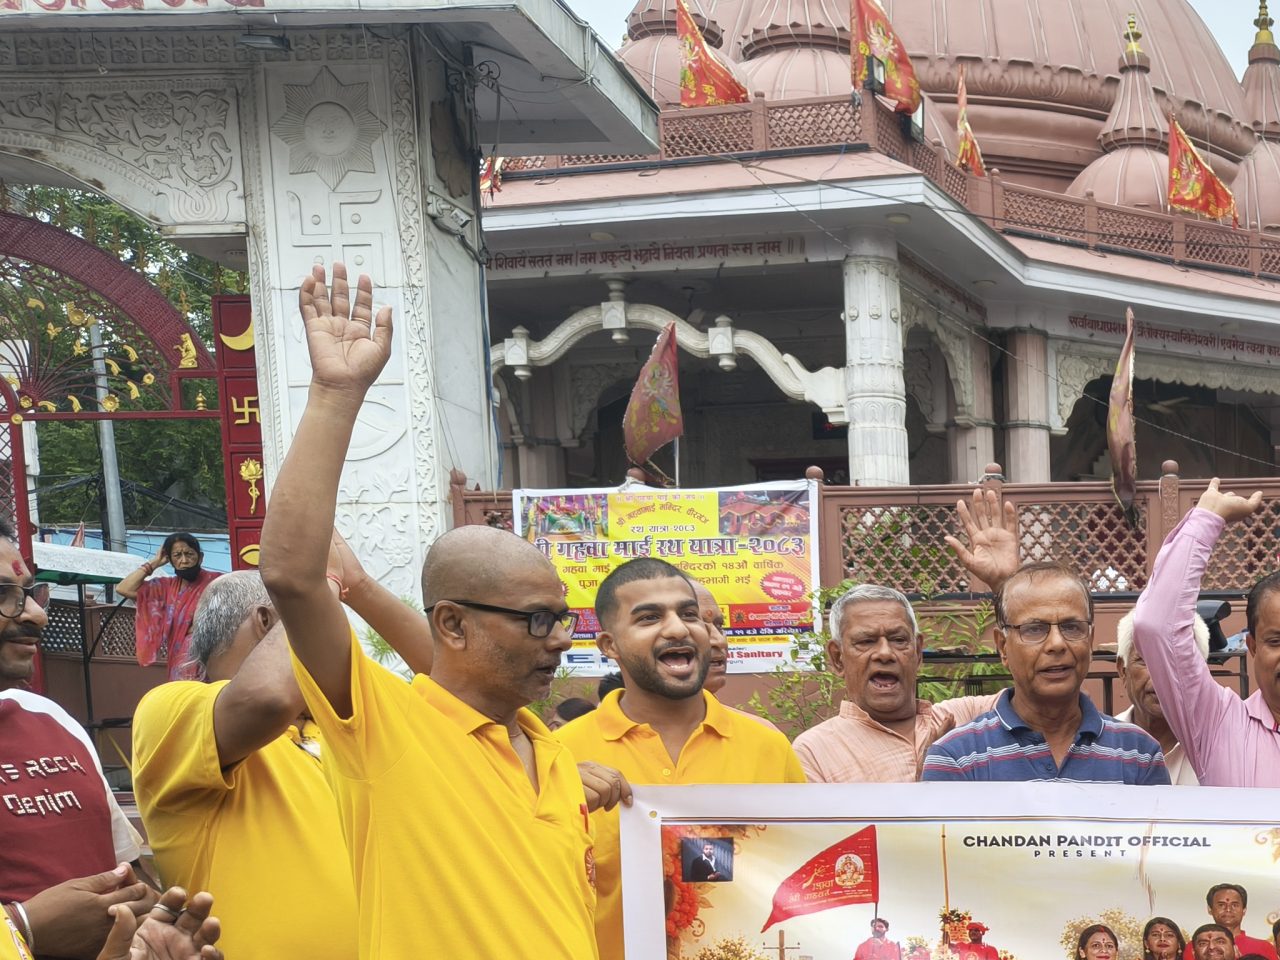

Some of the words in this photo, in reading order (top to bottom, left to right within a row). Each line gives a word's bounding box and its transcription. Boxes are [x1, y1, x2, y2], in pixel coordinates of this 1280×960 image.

[556, 540, 611, 563] गहवा
[613, 535, 653, 559] माई
[655, 538, 687, 557] रथ
[736, 651, 784, 660] Sanitary
[963, 835, 1052, 848] CHANDAN
[1056, 835, 1124, 848] PANDIT
[1127, 835, 1212, 848] OFFICIAL
